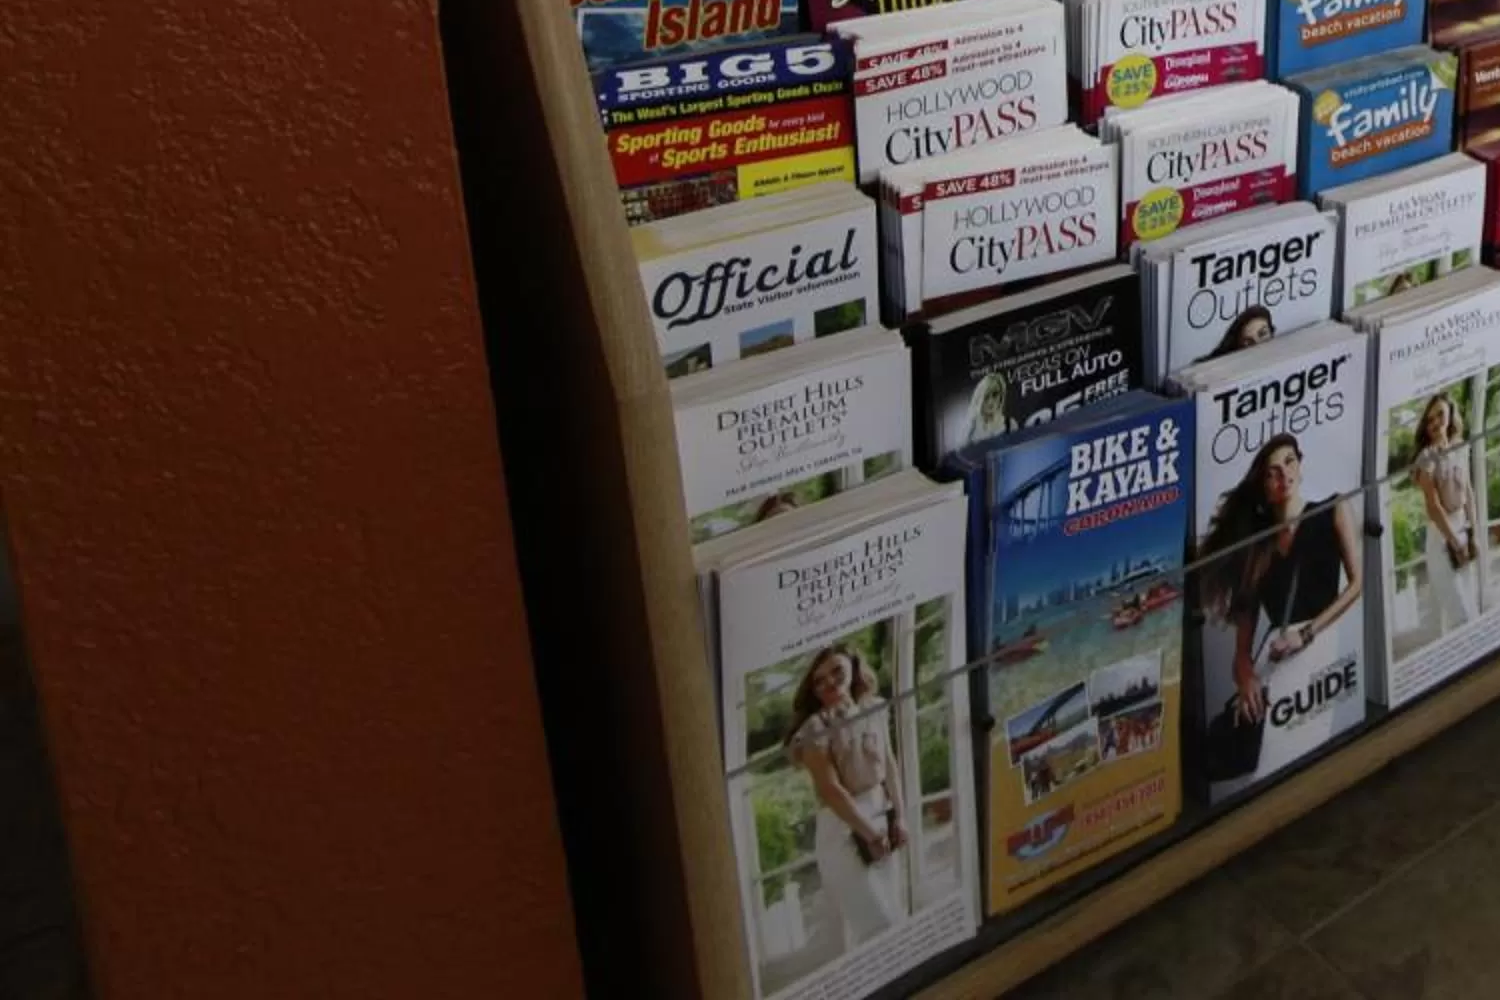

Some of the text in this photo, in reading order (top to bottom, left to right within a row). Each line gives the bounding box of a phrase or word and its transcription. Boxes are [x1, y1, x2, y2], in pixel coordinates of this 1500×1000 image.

[1120, 1, 1238, 51] CityPASS
[1302, 8, 1402, 41] beach vacation
[615, 43, 836, 93] BIG 5
[618, 72, 777, 103] SPORTING GOODS
[865, 62, 945, 93] SAVE 48%
[1113, 63, 1153, 82] SAVE
[611, 110, 635, 124] The
[636, 104, 678, 122] West's
[680, 97, 725, 115] Largest
[727, 90, 775, 110] Sporting
[777, 86, 811, 99] Goods
[886, 68, 1034, 125] HOLLYWOOD
[616, 115, 767, 154] Sporting Goods
[661, 122, 842, 169] Sports Enthusiast!
[885, 94, 1038, 167] CityPASS
[1330, 123, 1431, 163] beach vacation
[1146, 130, 1269, 184] CityPASS
[936, 171, 1014, 198] SAVE 48%
[952, 184, 1096, 232] HOLLYWOOD
[949, 211, 1097, 275] CityPASS
[1191, 228, 1325, 289] Tanger
[652, 229, 859, 331] Official
[723, 301, 755, 315] State
[757, 287, 795, 307] Visitor
[1187, 265, 1318, 330] Outlets
[1021, 349, 1123, 397] FULL AUTO
[1084, 368, 1130, 401] FREE
[1213, 352, 1350, 425] Tanger
[717, 375, 864, 432] DESERT HILLS
[737, 395, 846, 441] PREMIUM
[1211, 391, 1345, 465] Outlets
[739, 412, 848, 455] OUTLETS
[1069, 417, 1181, 478] BIKE &
[1067, 450, 1180, 511] KAYAK
[778, 526, 922, 590] DESERT HILLS
[797, 547, 904, 599] PREMIUM
[1270, 660, 1357, 729] GUIDE
